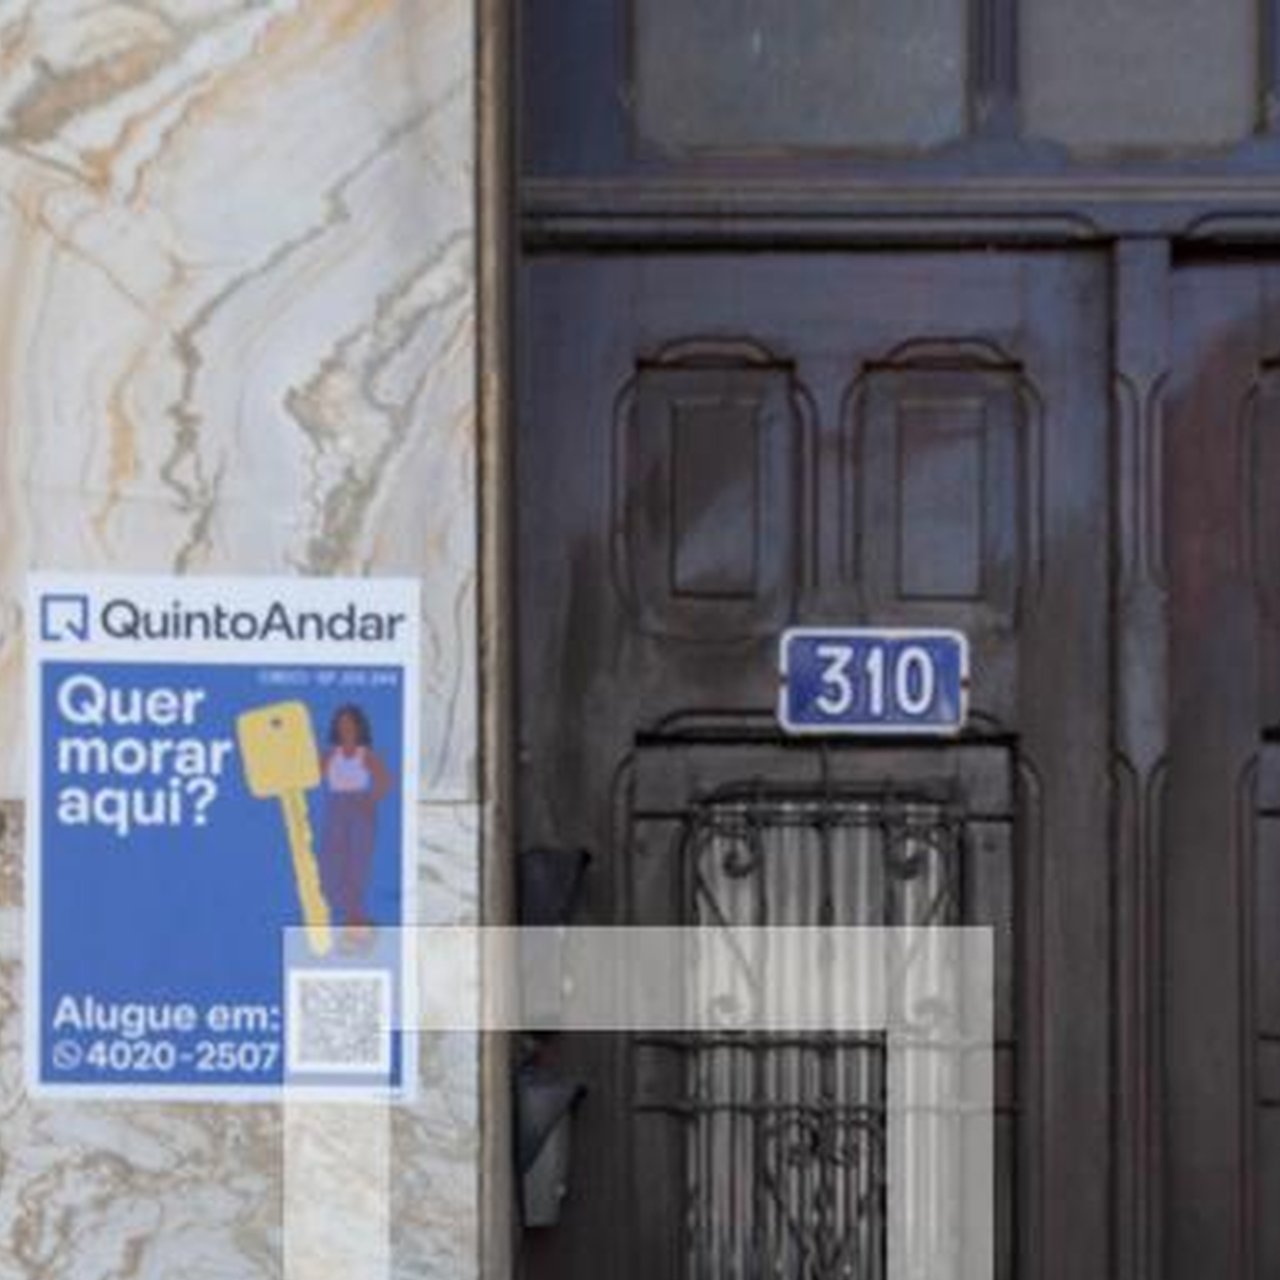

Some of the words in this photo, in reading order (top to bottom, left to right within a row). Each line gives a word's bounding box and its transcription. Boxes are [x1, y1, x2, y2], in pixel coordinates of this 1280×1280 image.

[101, 600, 405, 641] QuintoAndar
[57, 674, 205, 727] Quer
[816, 645, 934, 715] 310
[58, 735, 232, 775] morar
[57, 777, 218, 836] aqui?
[53, 996, 197, 1037] Alugue
[206, 1004, 280, 1030] em:
[87, 1041, 280, 1070] 4020-2507
